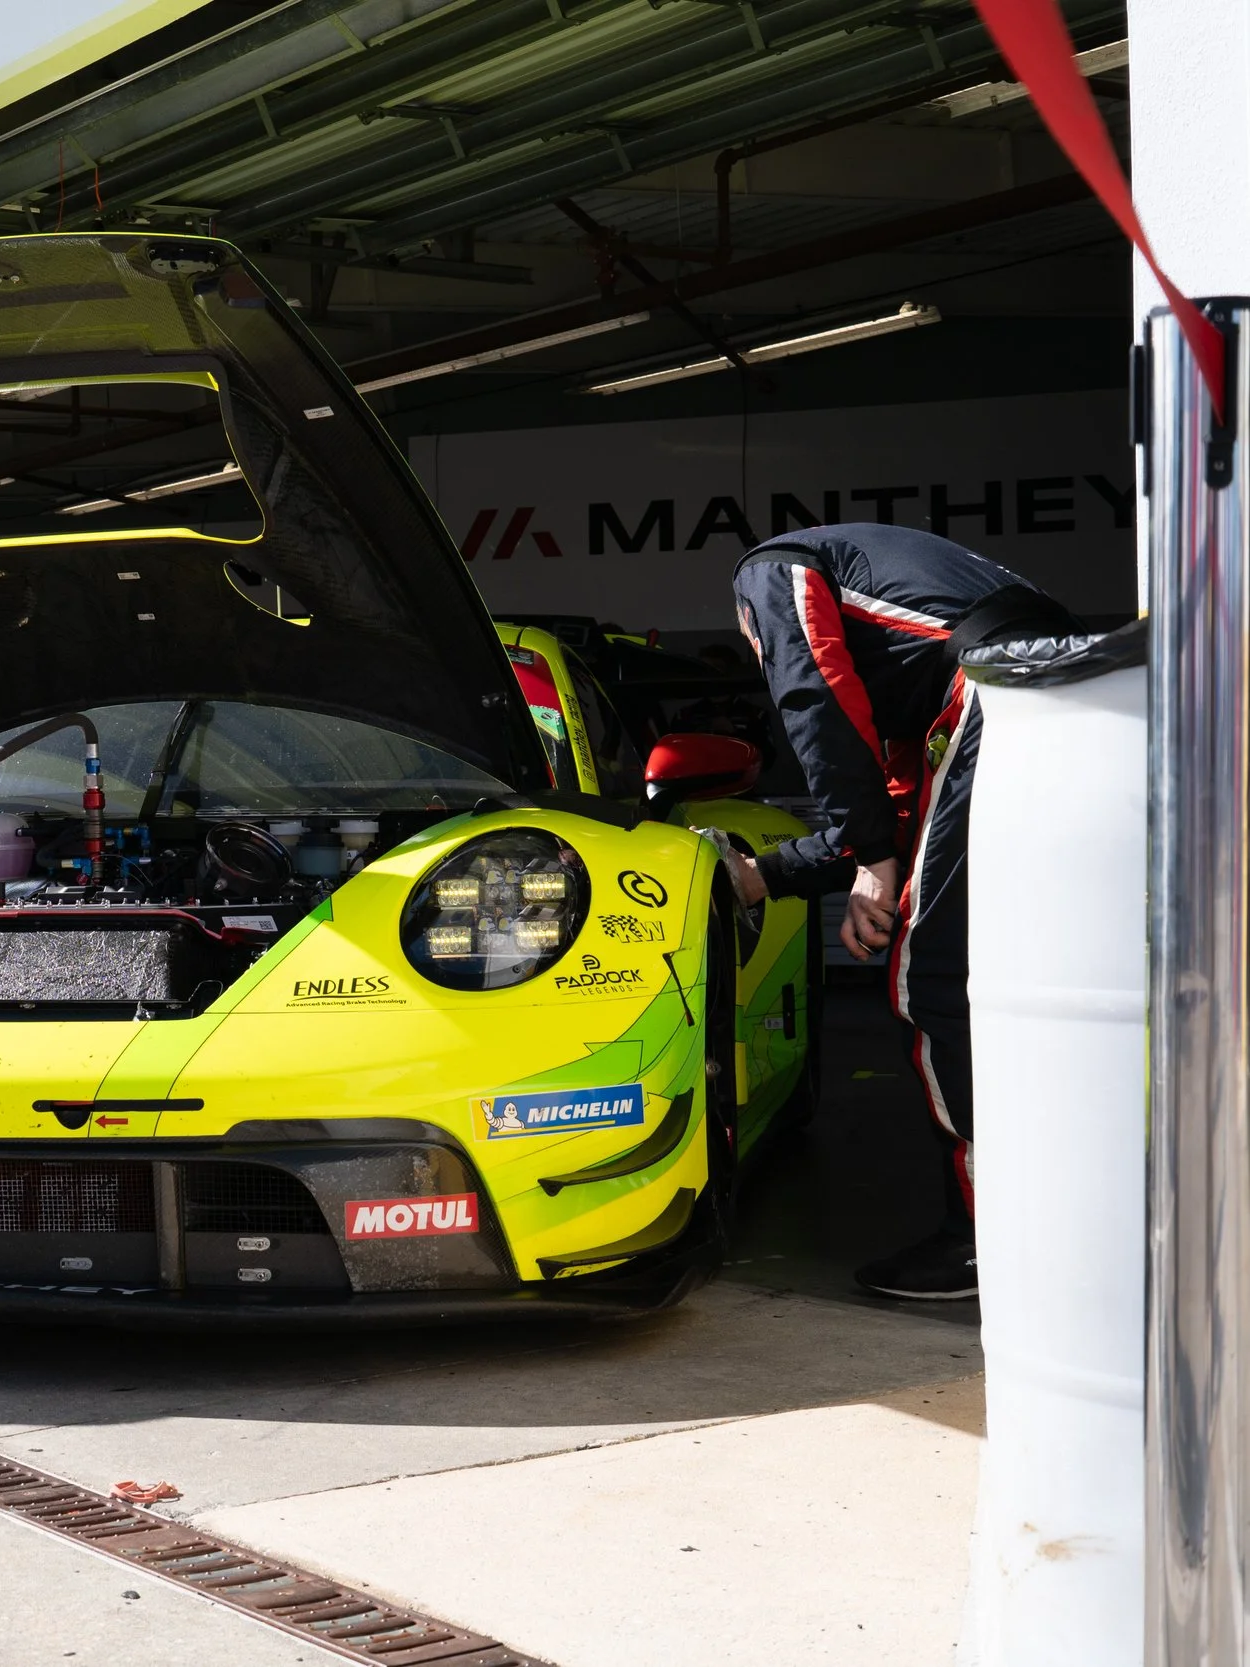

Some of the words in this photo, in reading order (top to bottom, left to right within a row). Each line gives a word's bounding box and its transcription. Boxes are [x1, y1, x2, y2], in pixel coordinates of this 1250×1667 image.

[588, 474, 1137, 556] MANTHEY
[614, 920, 665, 943] KW
[293, 975, 390, 997] ENDLESS
[554, 969, 643, 989] PADDOCK
[580, 984, 633, 996] LEGENDS
[527, 1098, 633, 1123] MICHELIN
[352, 1200, 472, 1234] MOTUL
